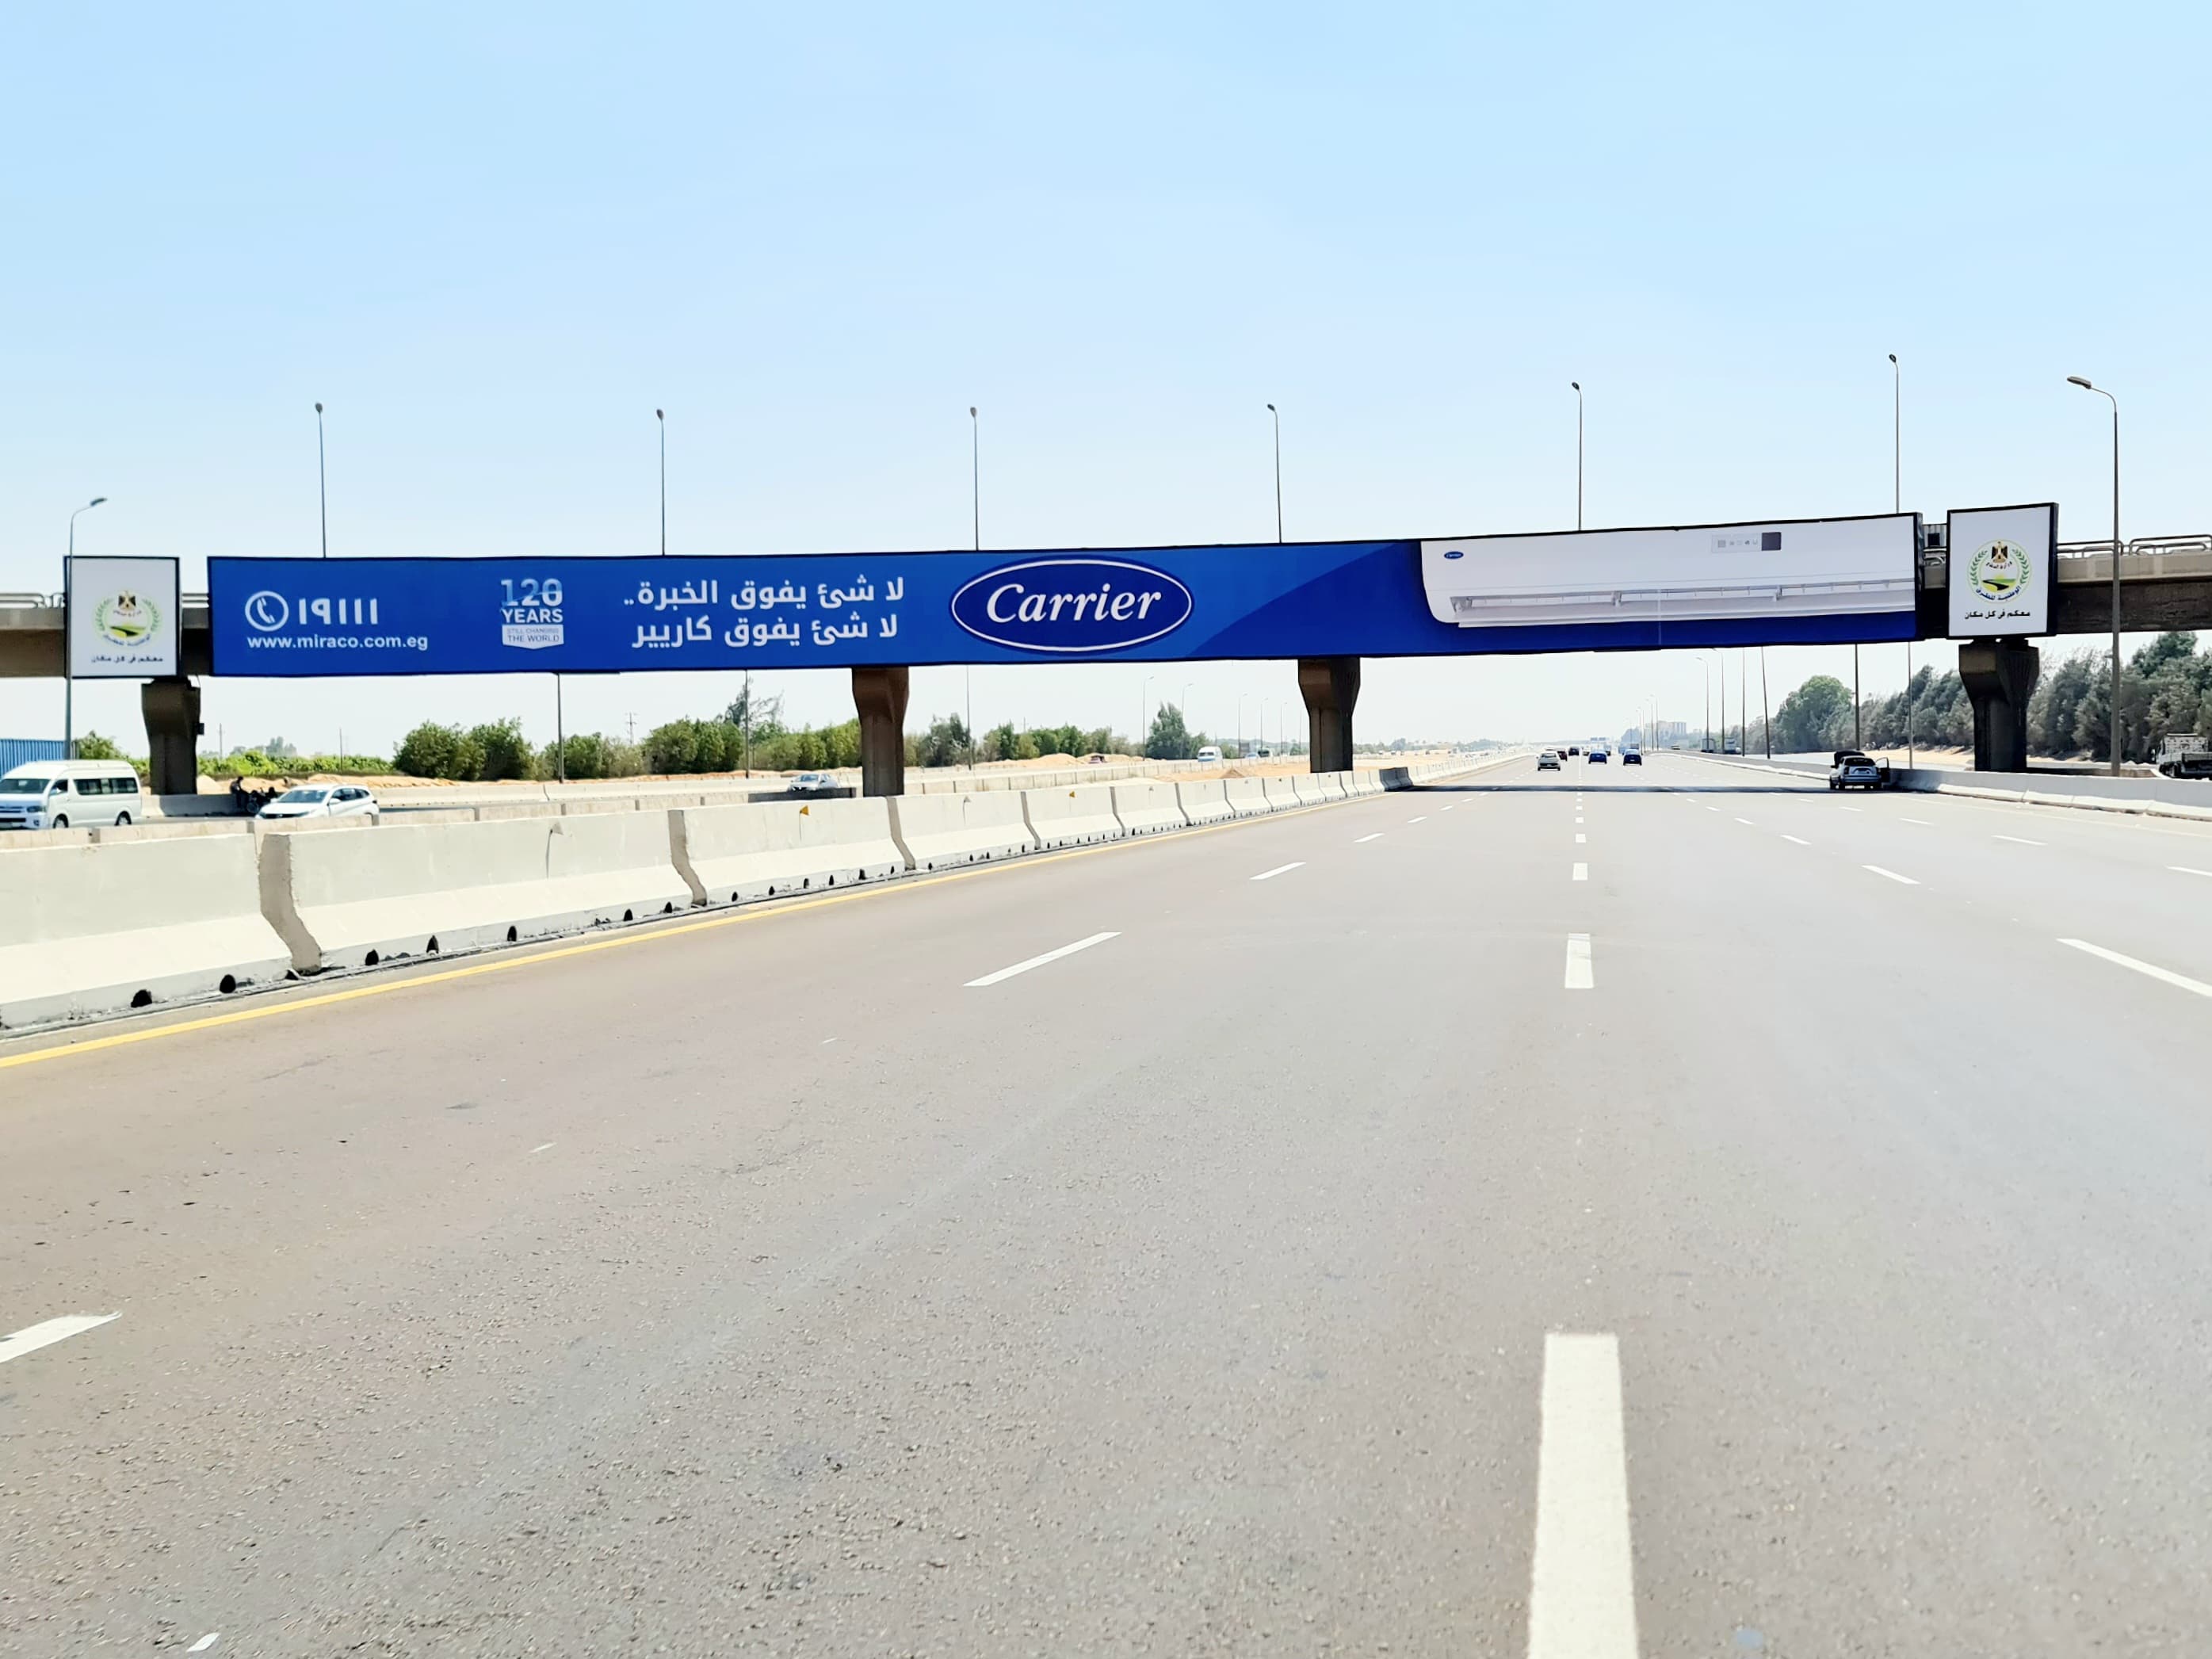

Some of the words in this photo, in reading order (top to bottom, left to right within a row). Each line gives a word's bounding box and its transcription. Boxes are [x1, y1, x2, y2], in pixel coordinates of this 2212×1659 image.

[500, 579, 563, 606] 120
[731, 580, 807, 610] يفوق
[885, 577, 904, 601] لا
[502, 608, 564, 623] YEARS
[986, 583, 1162, 623] Carrier
[632, 615, 713, 648] كاريير
[724, 617, 800, 647] يفوق
[879, 614, 898, 637] لا
[247, 634, 429, 651] www.miraco.com.eg
